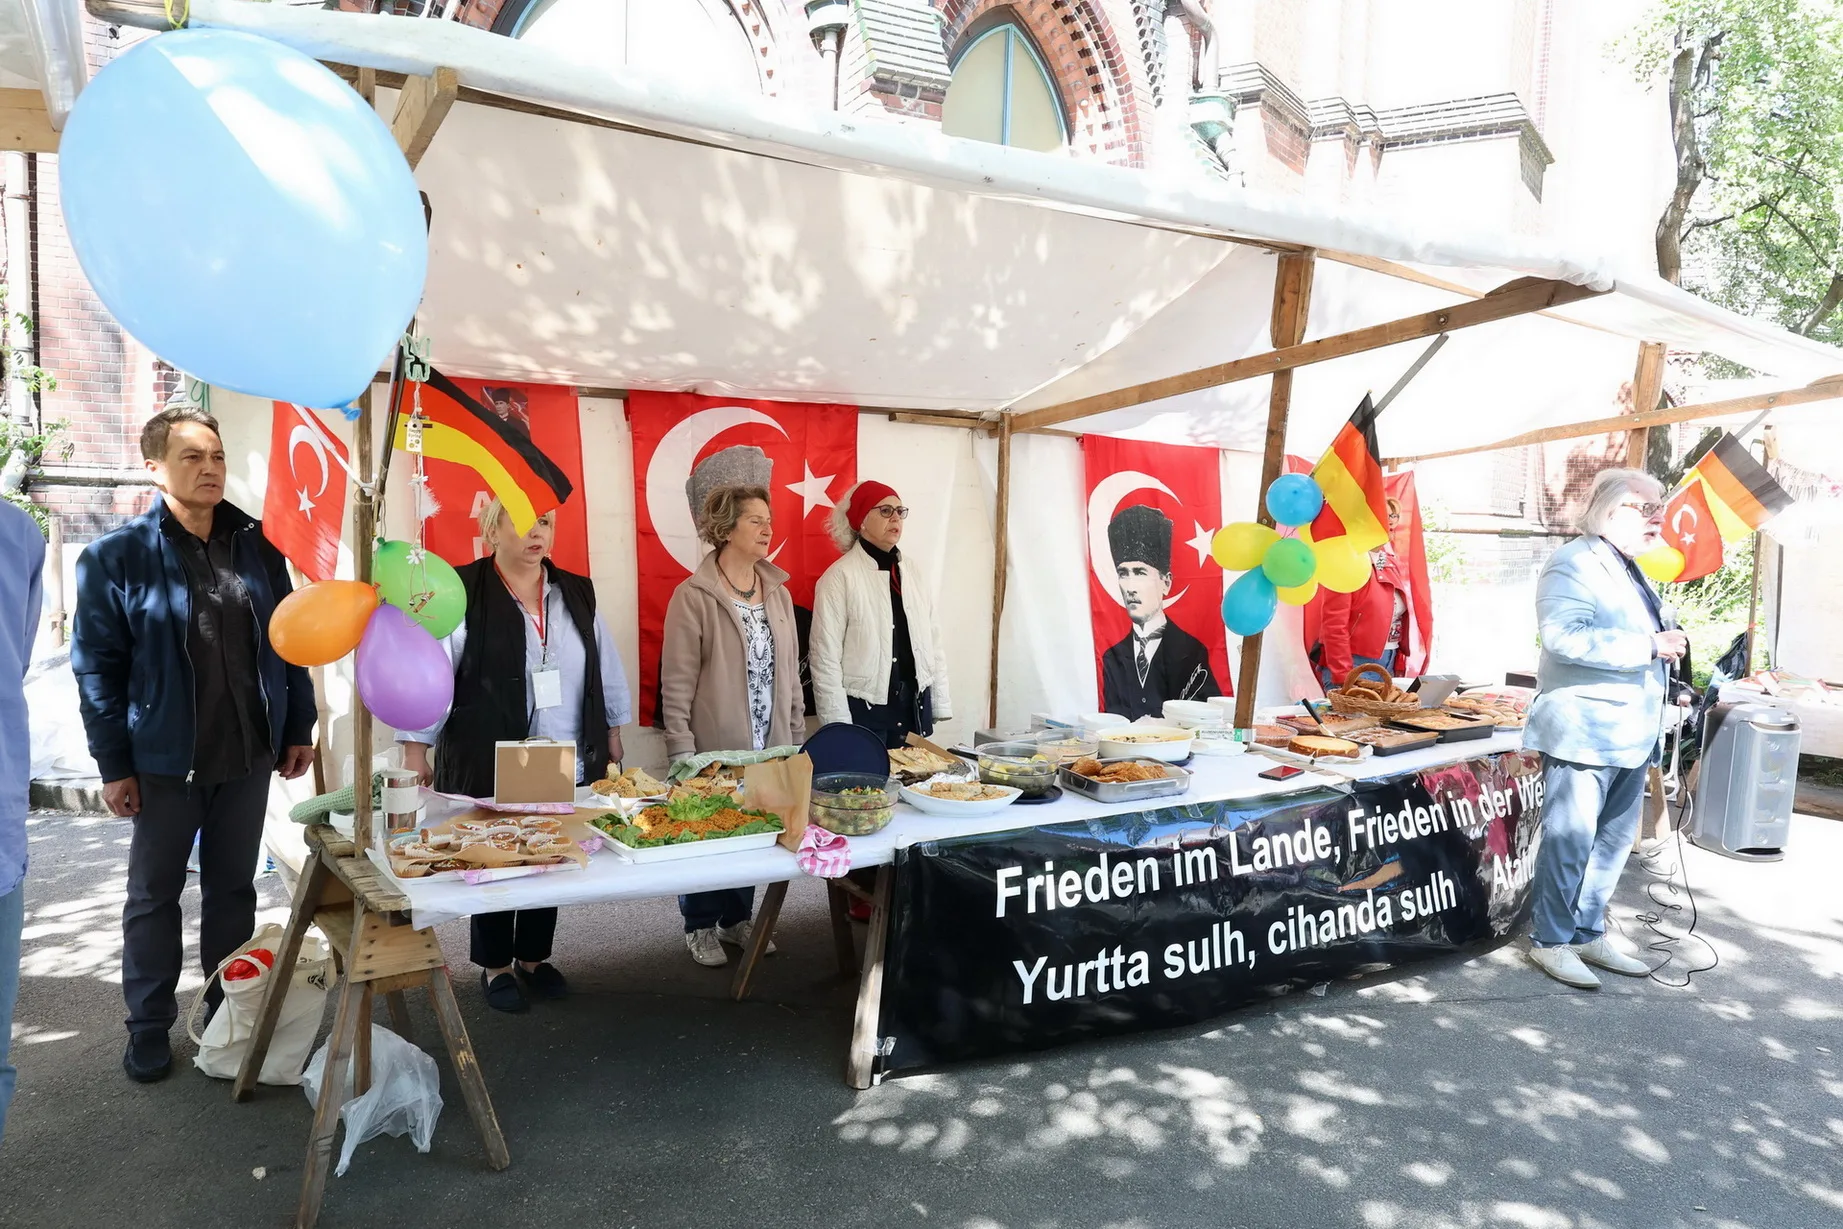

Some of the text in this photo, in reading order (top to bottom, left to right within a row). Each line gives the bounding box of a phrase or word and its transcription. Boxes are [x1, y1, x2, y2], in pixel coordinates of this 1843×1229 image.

[996, 853, 1160, 918] Frieden
[1173, 843, 1218, 887] im
[1229, 817, 1341, 876] Lande,
[1348, 798, 1448, 852] Frieden
[1447, 790, 1476, 828] in
[1477, 783, 1514, 822] der
[1012, 870, 1457, 1004] Yurtta sulh, cihanda sulh
